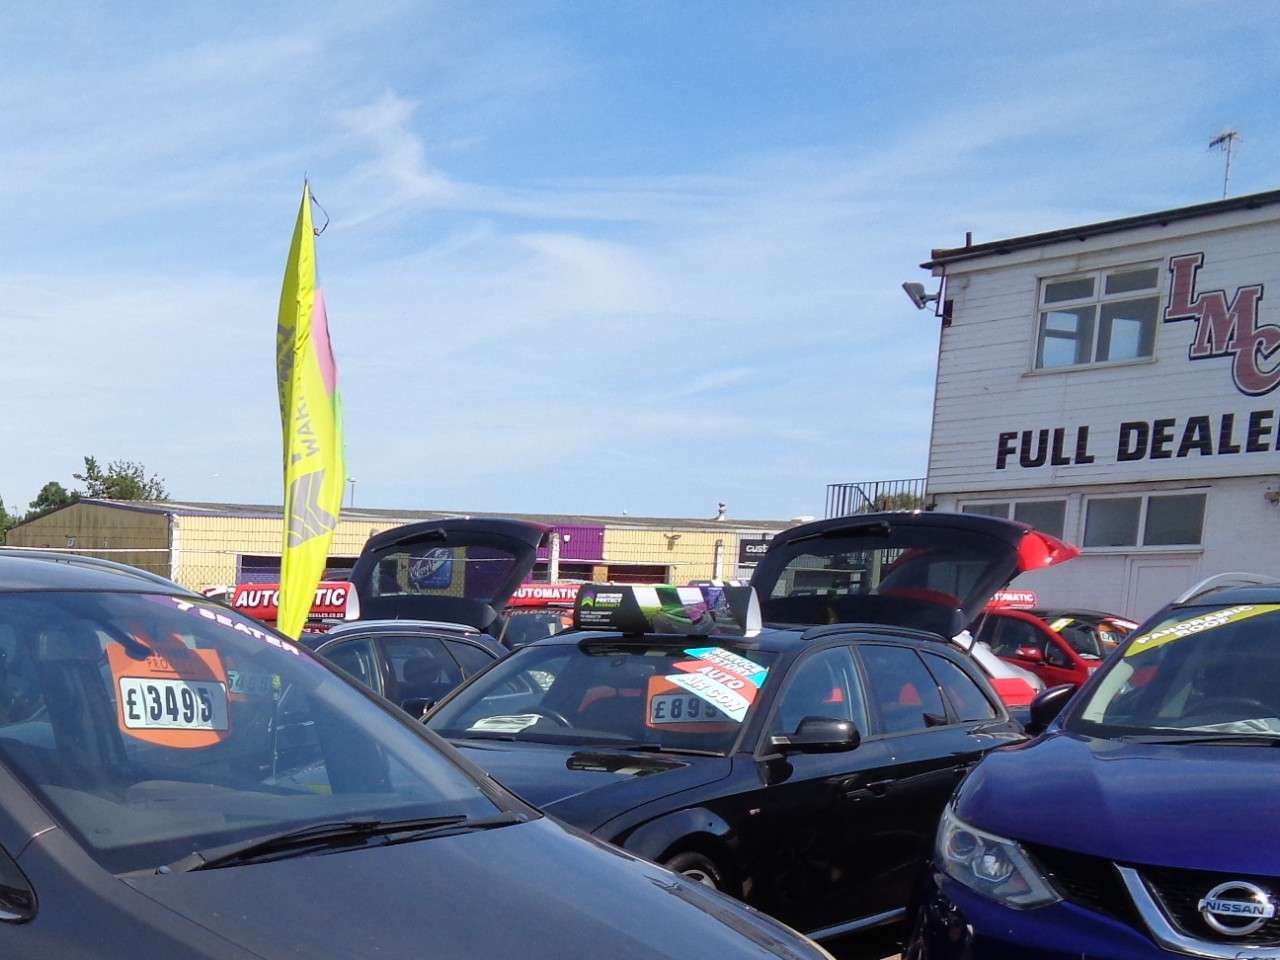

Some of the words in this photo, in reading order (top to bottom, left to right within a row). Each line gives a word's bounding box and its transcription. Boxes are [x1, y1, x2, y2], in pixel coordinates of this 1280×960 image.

[996, 426, 1094, 469] FULL
[1117, 409, 1280, 462] DEALE
[172, 597, 195, 611] 7
[199, 609, 300, 656] SEATER
[1136, 605, 1255, 643] PANORAMIC
[1175, 617, 1229, 637] ROOF
[701, 653, 750, 677] HISTORY
[712, 648, 759, 672] SERVICE
[696, 666, 744, 689] AUTO
[126, 685, 213, 724] £3495
[679, 676, 708, 692] AIR
[705, 688, 744, 712] CON
[1205, 901, 1265, 915] NISSAN
